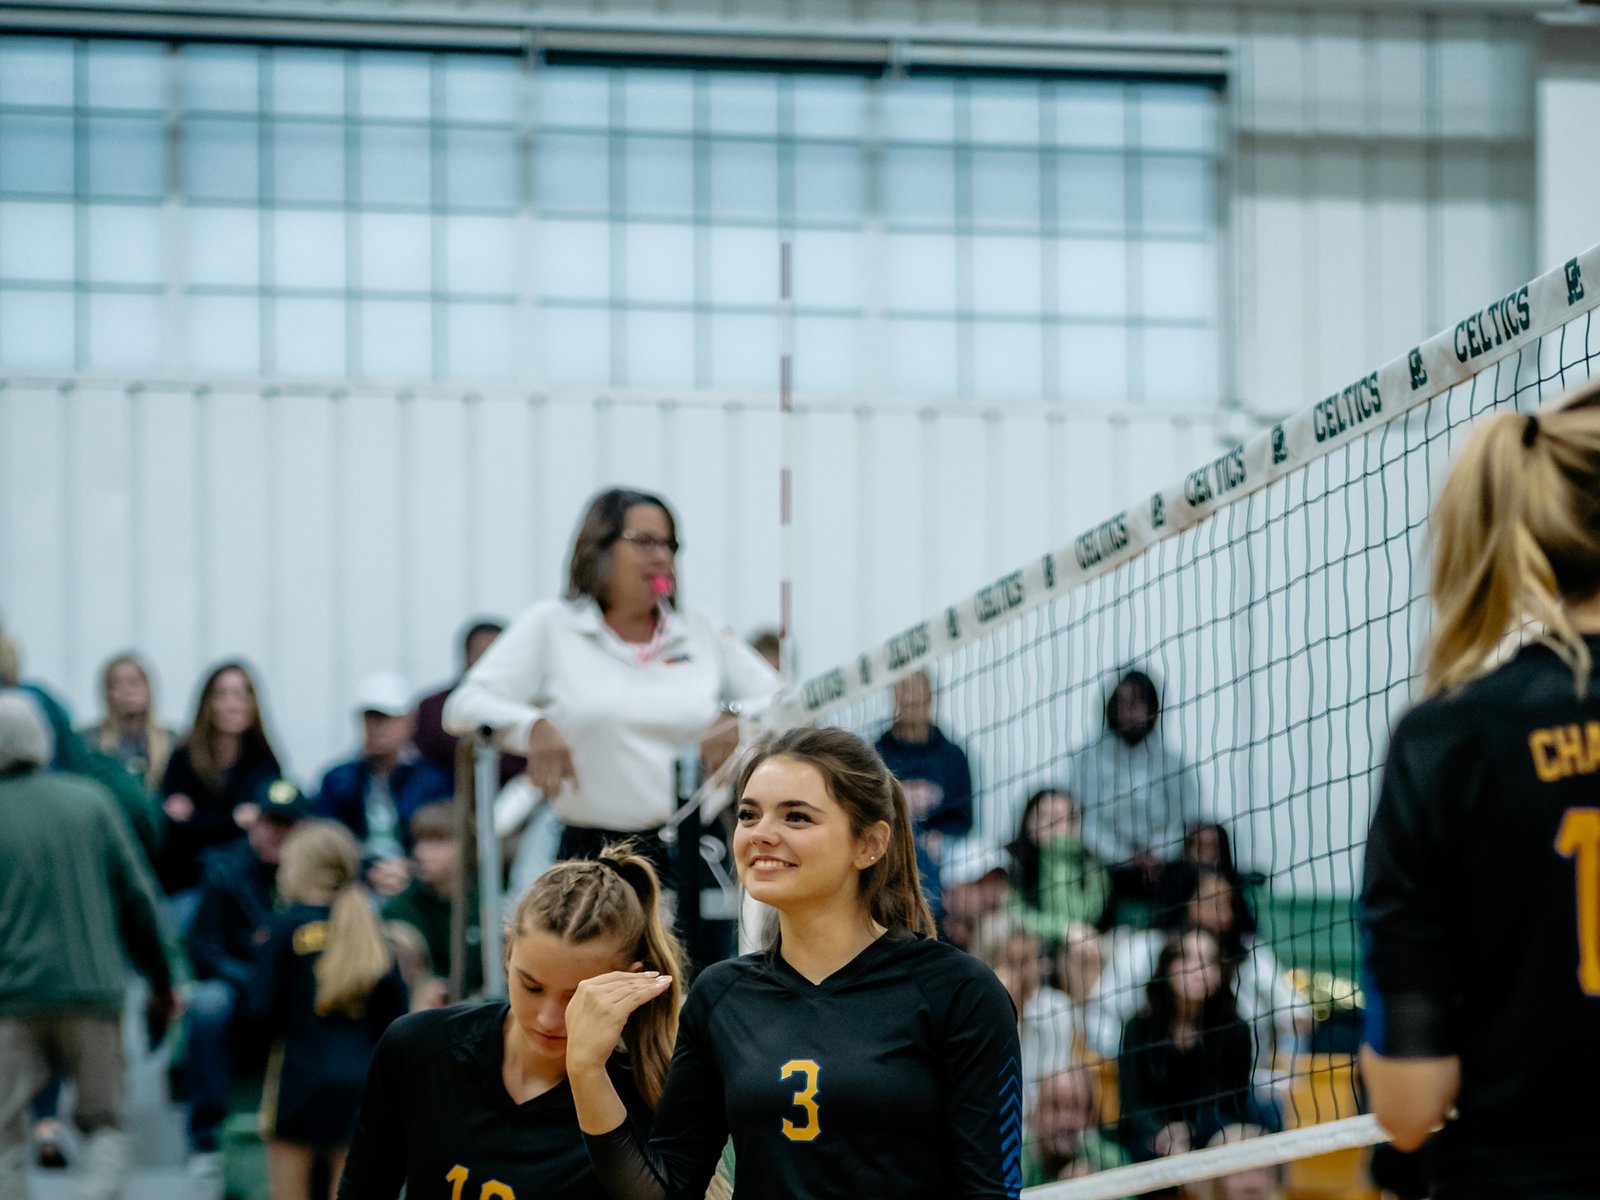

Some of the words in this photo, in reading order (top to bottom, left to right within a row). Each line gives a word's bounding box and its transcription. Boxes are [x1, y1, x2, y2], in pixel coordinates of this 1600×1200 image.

[1185, 446, 1245, 506] CELTICS
[1314, 372, 1383, 442] CELTICS
[1454, 286, 1530, 362] CELTICS
[780, 1060, 820, 1141] 3
